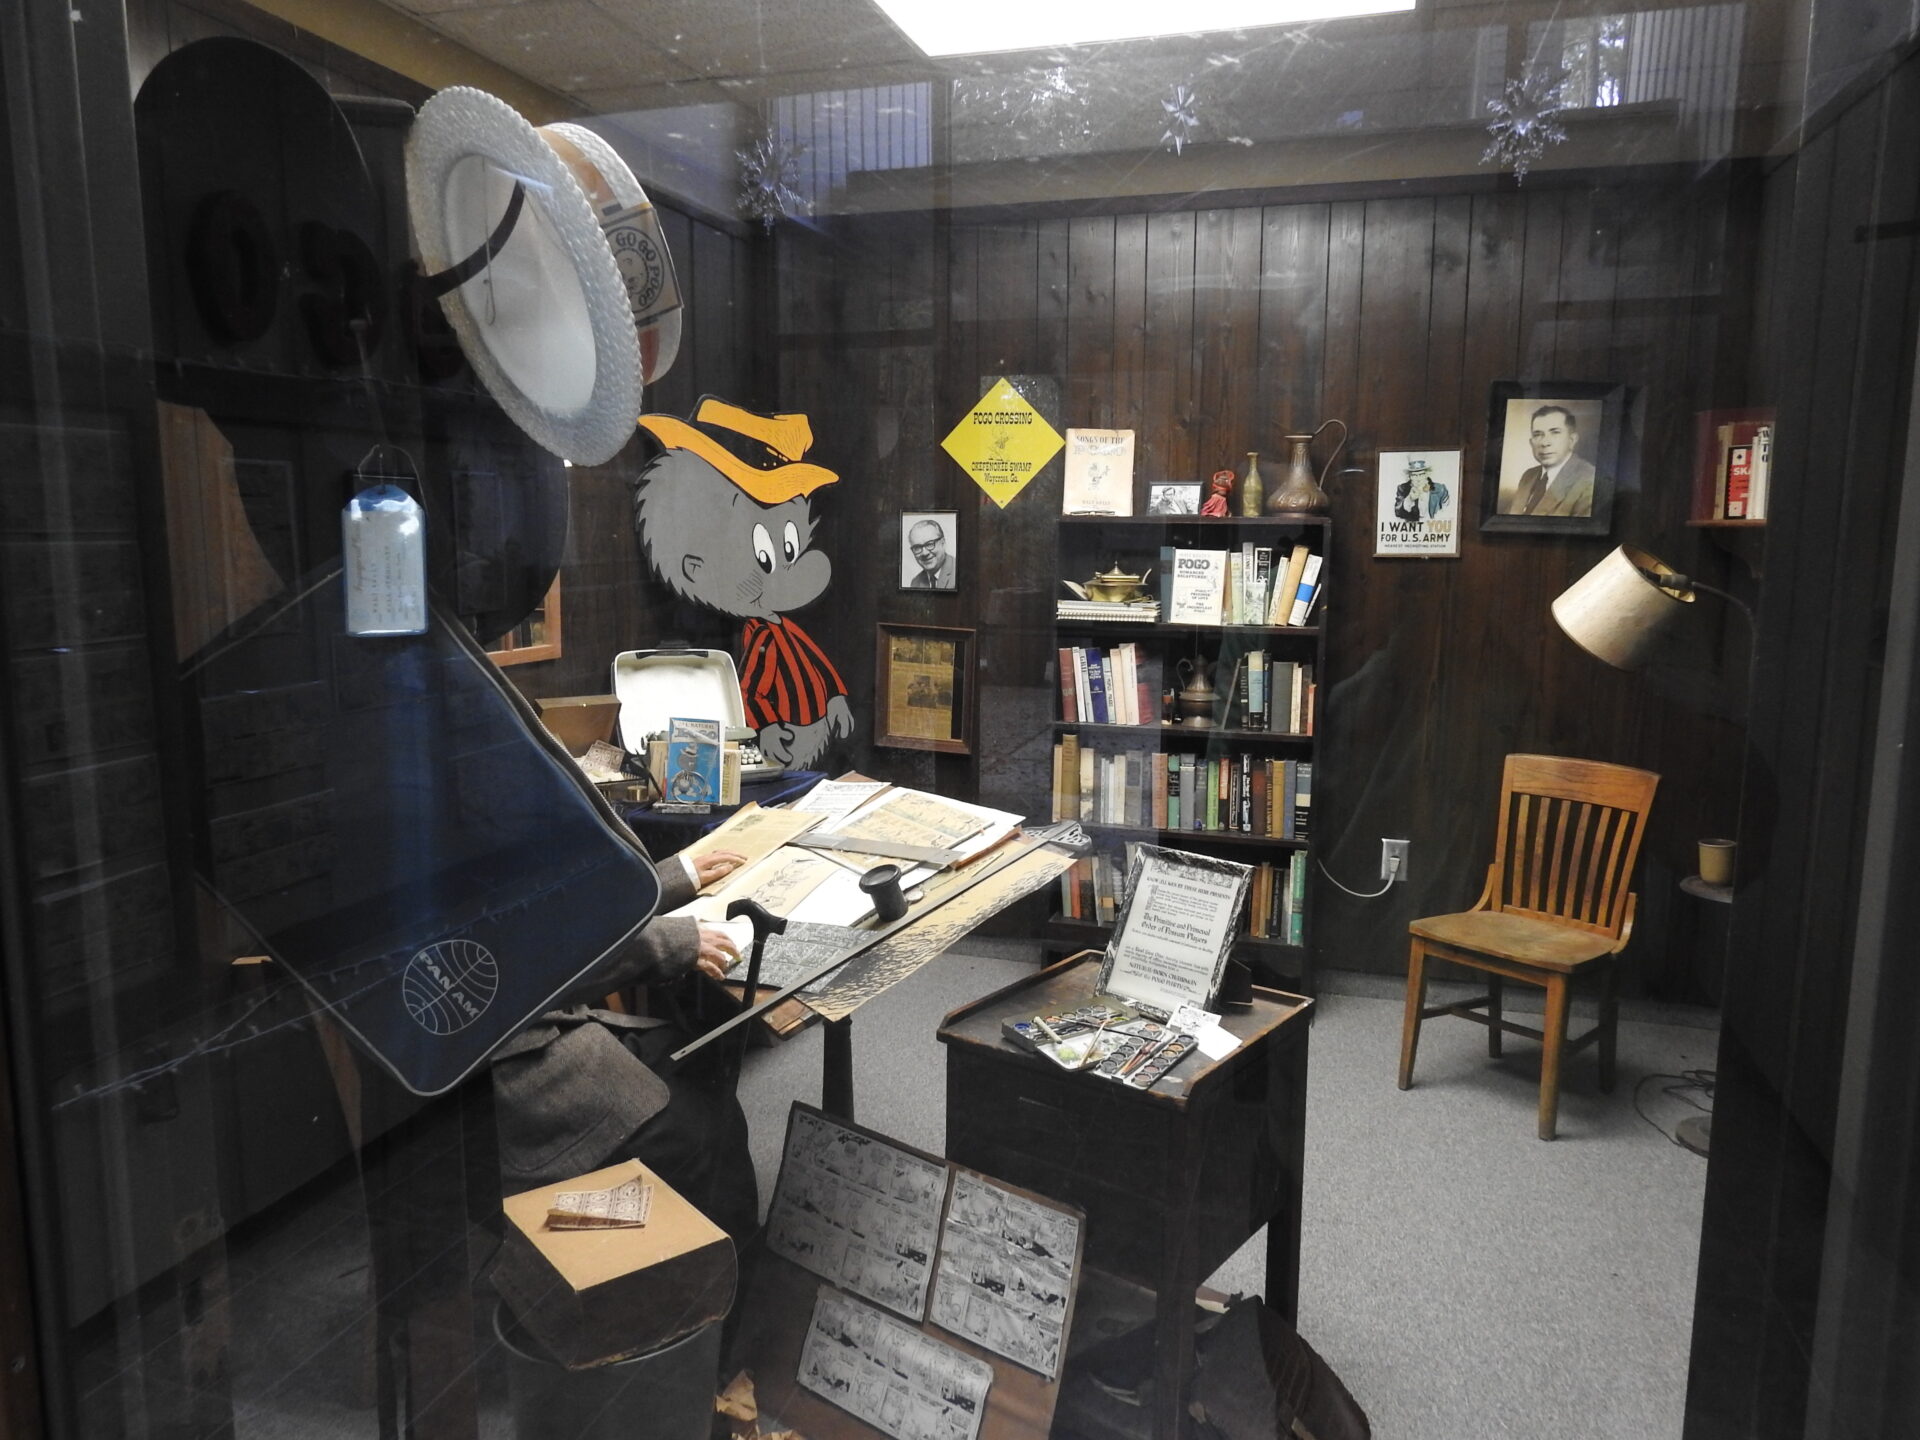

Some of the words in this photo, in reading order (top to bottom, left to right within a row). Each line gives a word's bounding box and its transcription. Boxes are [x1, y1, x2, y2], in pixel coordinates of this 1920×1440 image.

[616, 232, 636, 246] GO
[638, 240, 657, 262] GO
[638, 266, 660, 306] POGO
[973, 412, 992, 425] POGO
[994, 412, 1032, 425] CROSSING
[1076, 436, 1098, 444] SONGS
[1010, 462, 1032, 472] SWAMP
[1381, 522, 1384, 532] I
[1389, 522, 1424, 532] WANT
[1427, 520, 1452, 533] YOU
[1380, 534, 1397, 542] FOR
[1423, 533, 1451, 542] ARMY
[1178, 558, 1210, 570] POGO
[418, 951, 456, 990] PAN
[452, 992, 480, 1018] AM
